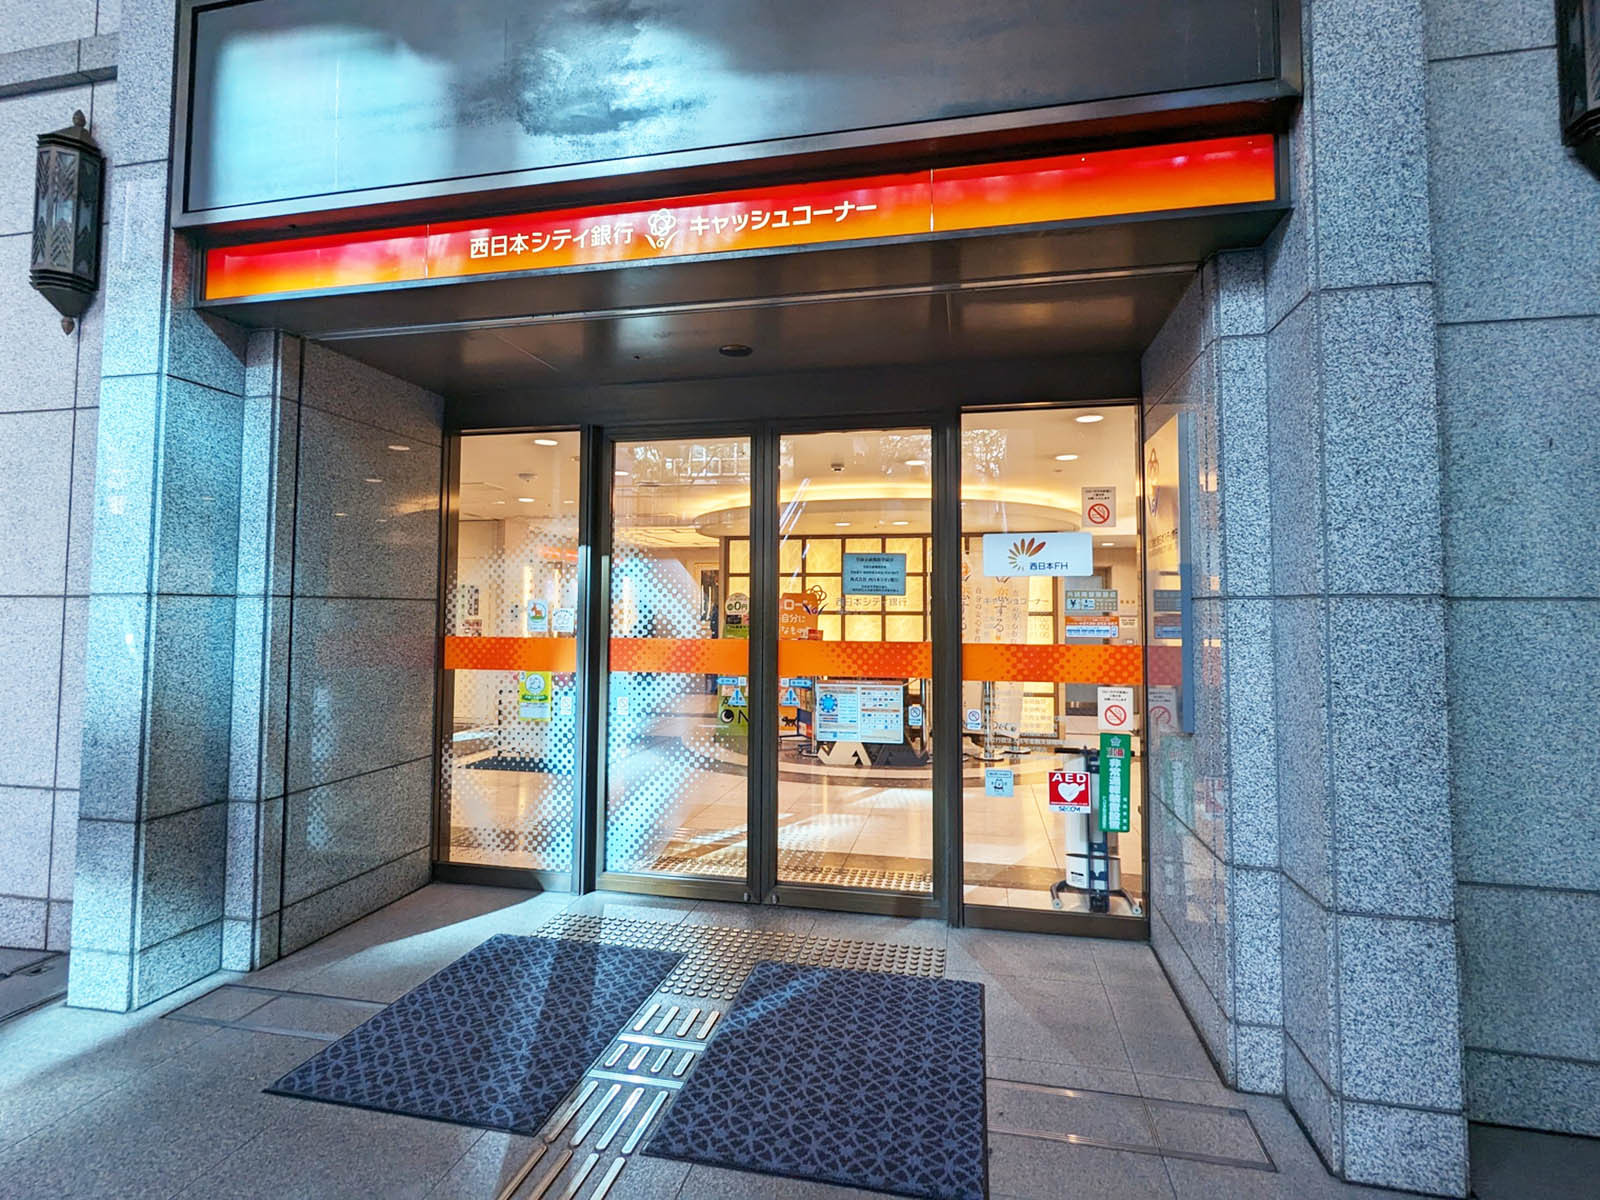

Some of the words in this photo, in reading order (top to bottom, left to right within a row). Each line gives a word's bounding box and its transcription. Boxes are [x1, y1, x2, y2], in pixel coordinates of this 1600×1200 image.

[469, 222, 634, 259] 西日本シティ銀行
[689, 200, 877, 235] キャッシュコーナー
[1029, 561, 1069, 570] 西日本FH
[1051, 773, 1087, 783] AED
